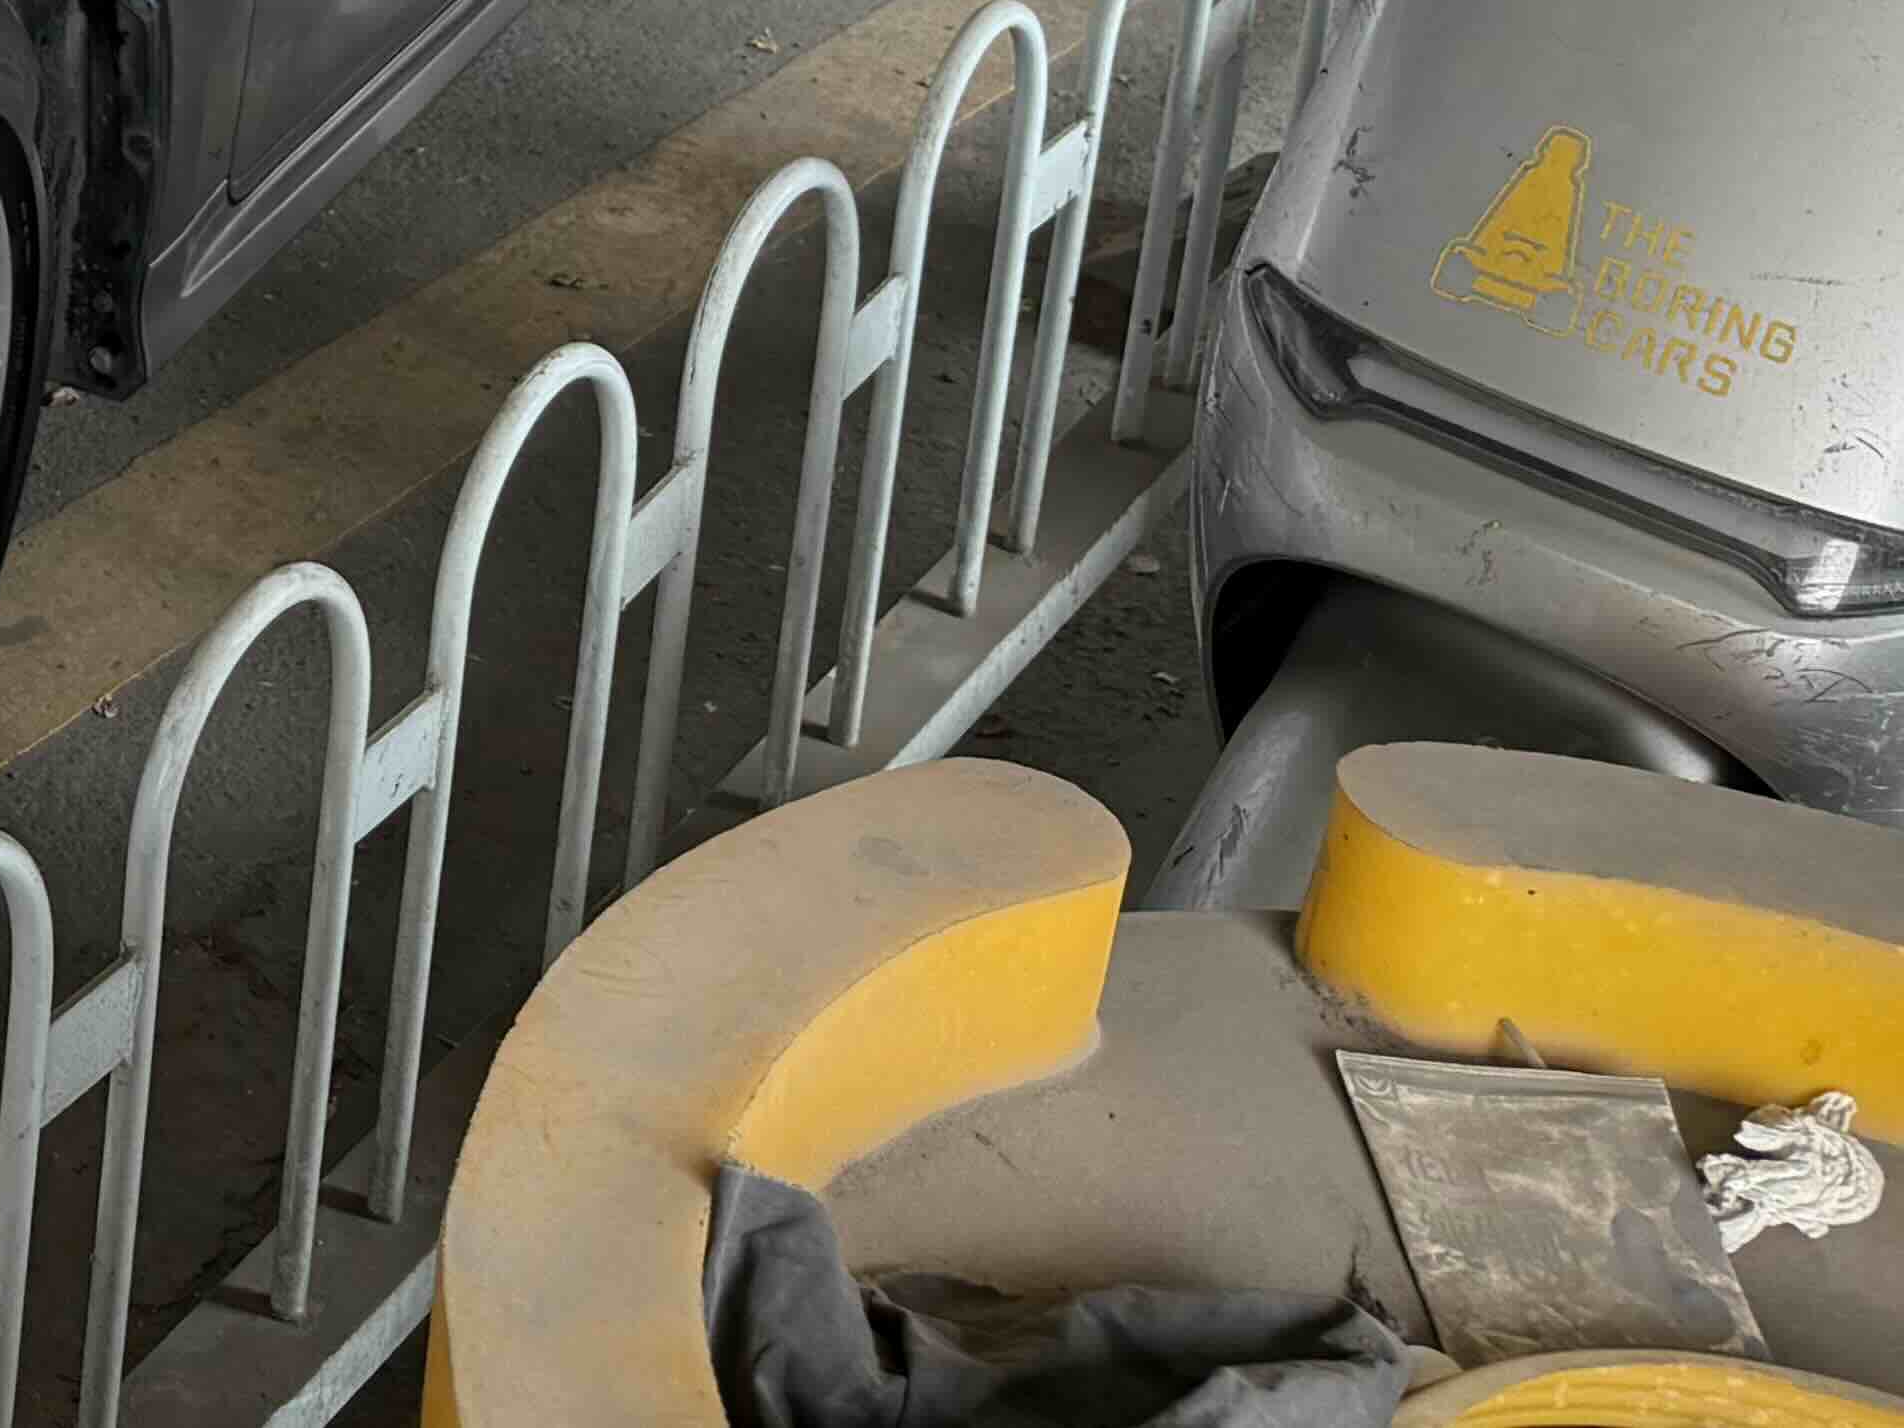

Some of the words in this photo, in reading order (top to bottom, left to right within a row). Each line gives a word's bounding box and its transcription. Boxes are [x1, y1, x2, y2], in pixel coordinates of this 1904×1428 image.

[1599, 199, 1697, 270] THE
[1594, 255, 1797, 364] BORING
[1585, 310, 1737, 398] CARS
